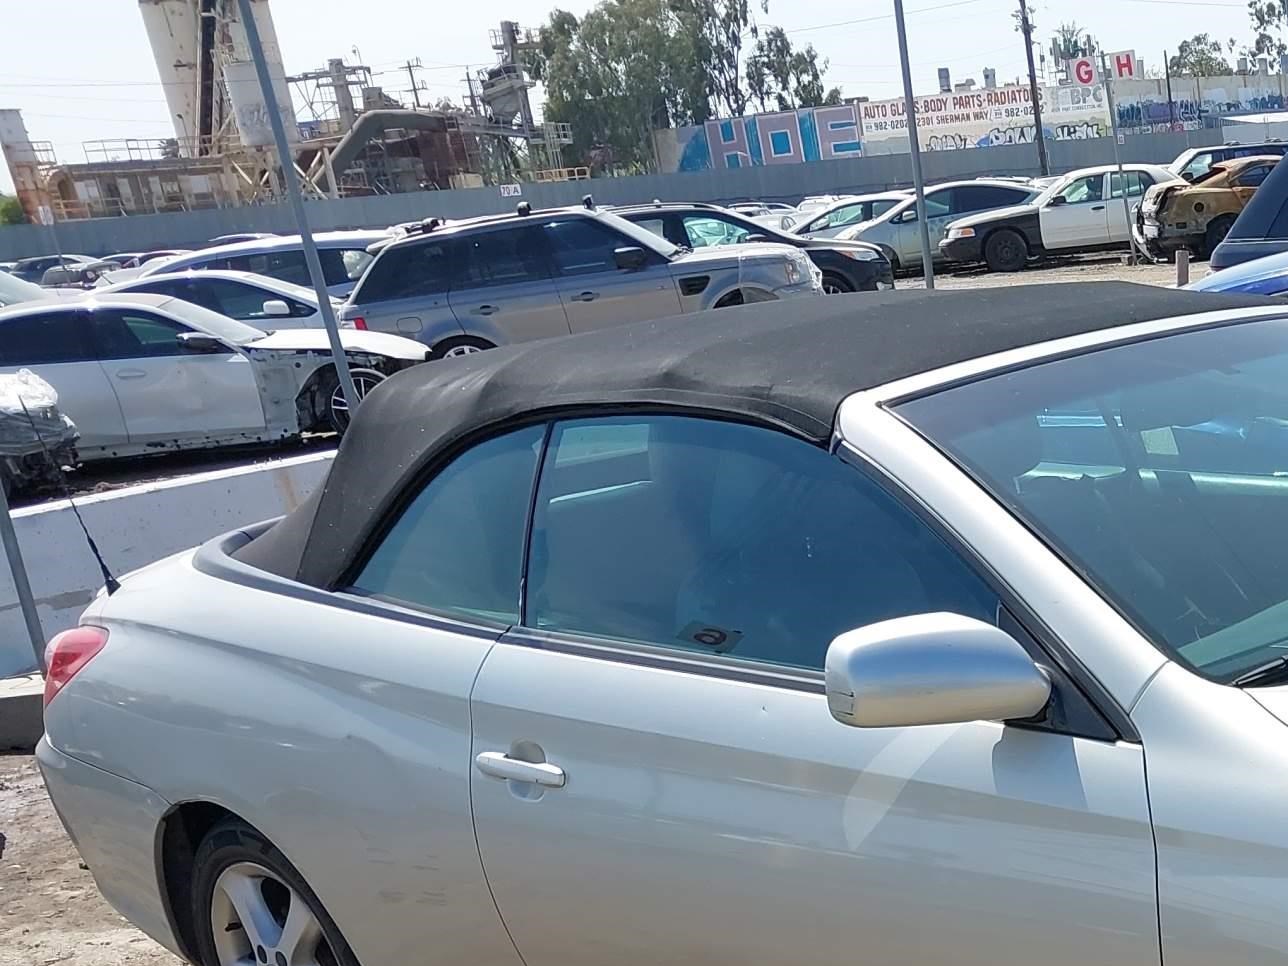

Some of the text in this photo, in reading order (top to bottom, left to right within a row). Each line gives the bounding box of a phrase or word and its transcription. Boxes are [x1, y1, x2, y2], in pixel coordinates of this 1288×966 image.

[1075, 60, 1093, 84] G
[1115, 54, 1133, 77] H
[864, 104, 887, 119] AUTO
[890, 100, 920, 117] GLAS
[987, 87, 1043, 107] RADIATOS
[1070, 86, 1103, 105] BPC
[936, 113, 971, 125] SHERMAN
